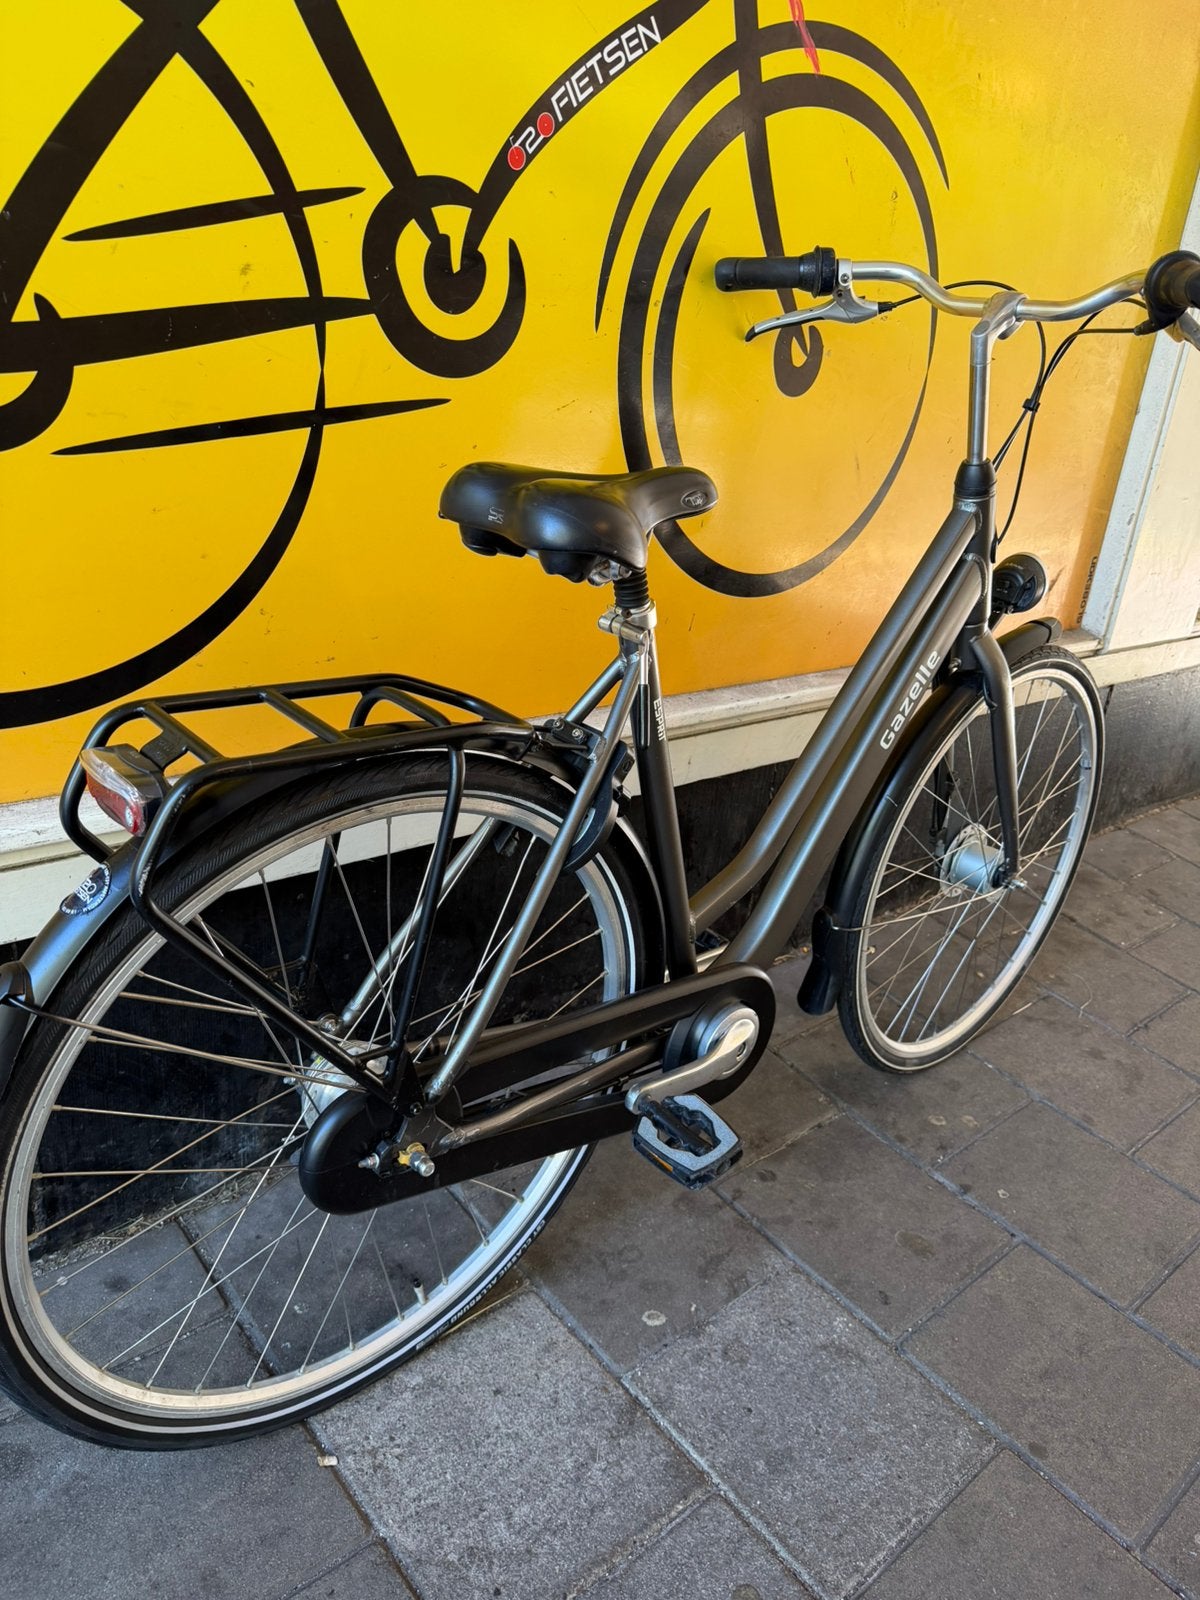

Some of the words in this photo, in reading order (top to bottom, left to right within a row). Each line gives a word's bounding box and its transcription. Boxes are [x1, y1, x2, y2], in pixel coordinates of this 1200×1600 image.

[550, 15, 662, 123] FIETSEN
[880, 650, 941, 750] Gazelle
[450, 1276, 498, 1324] ALLROUND
